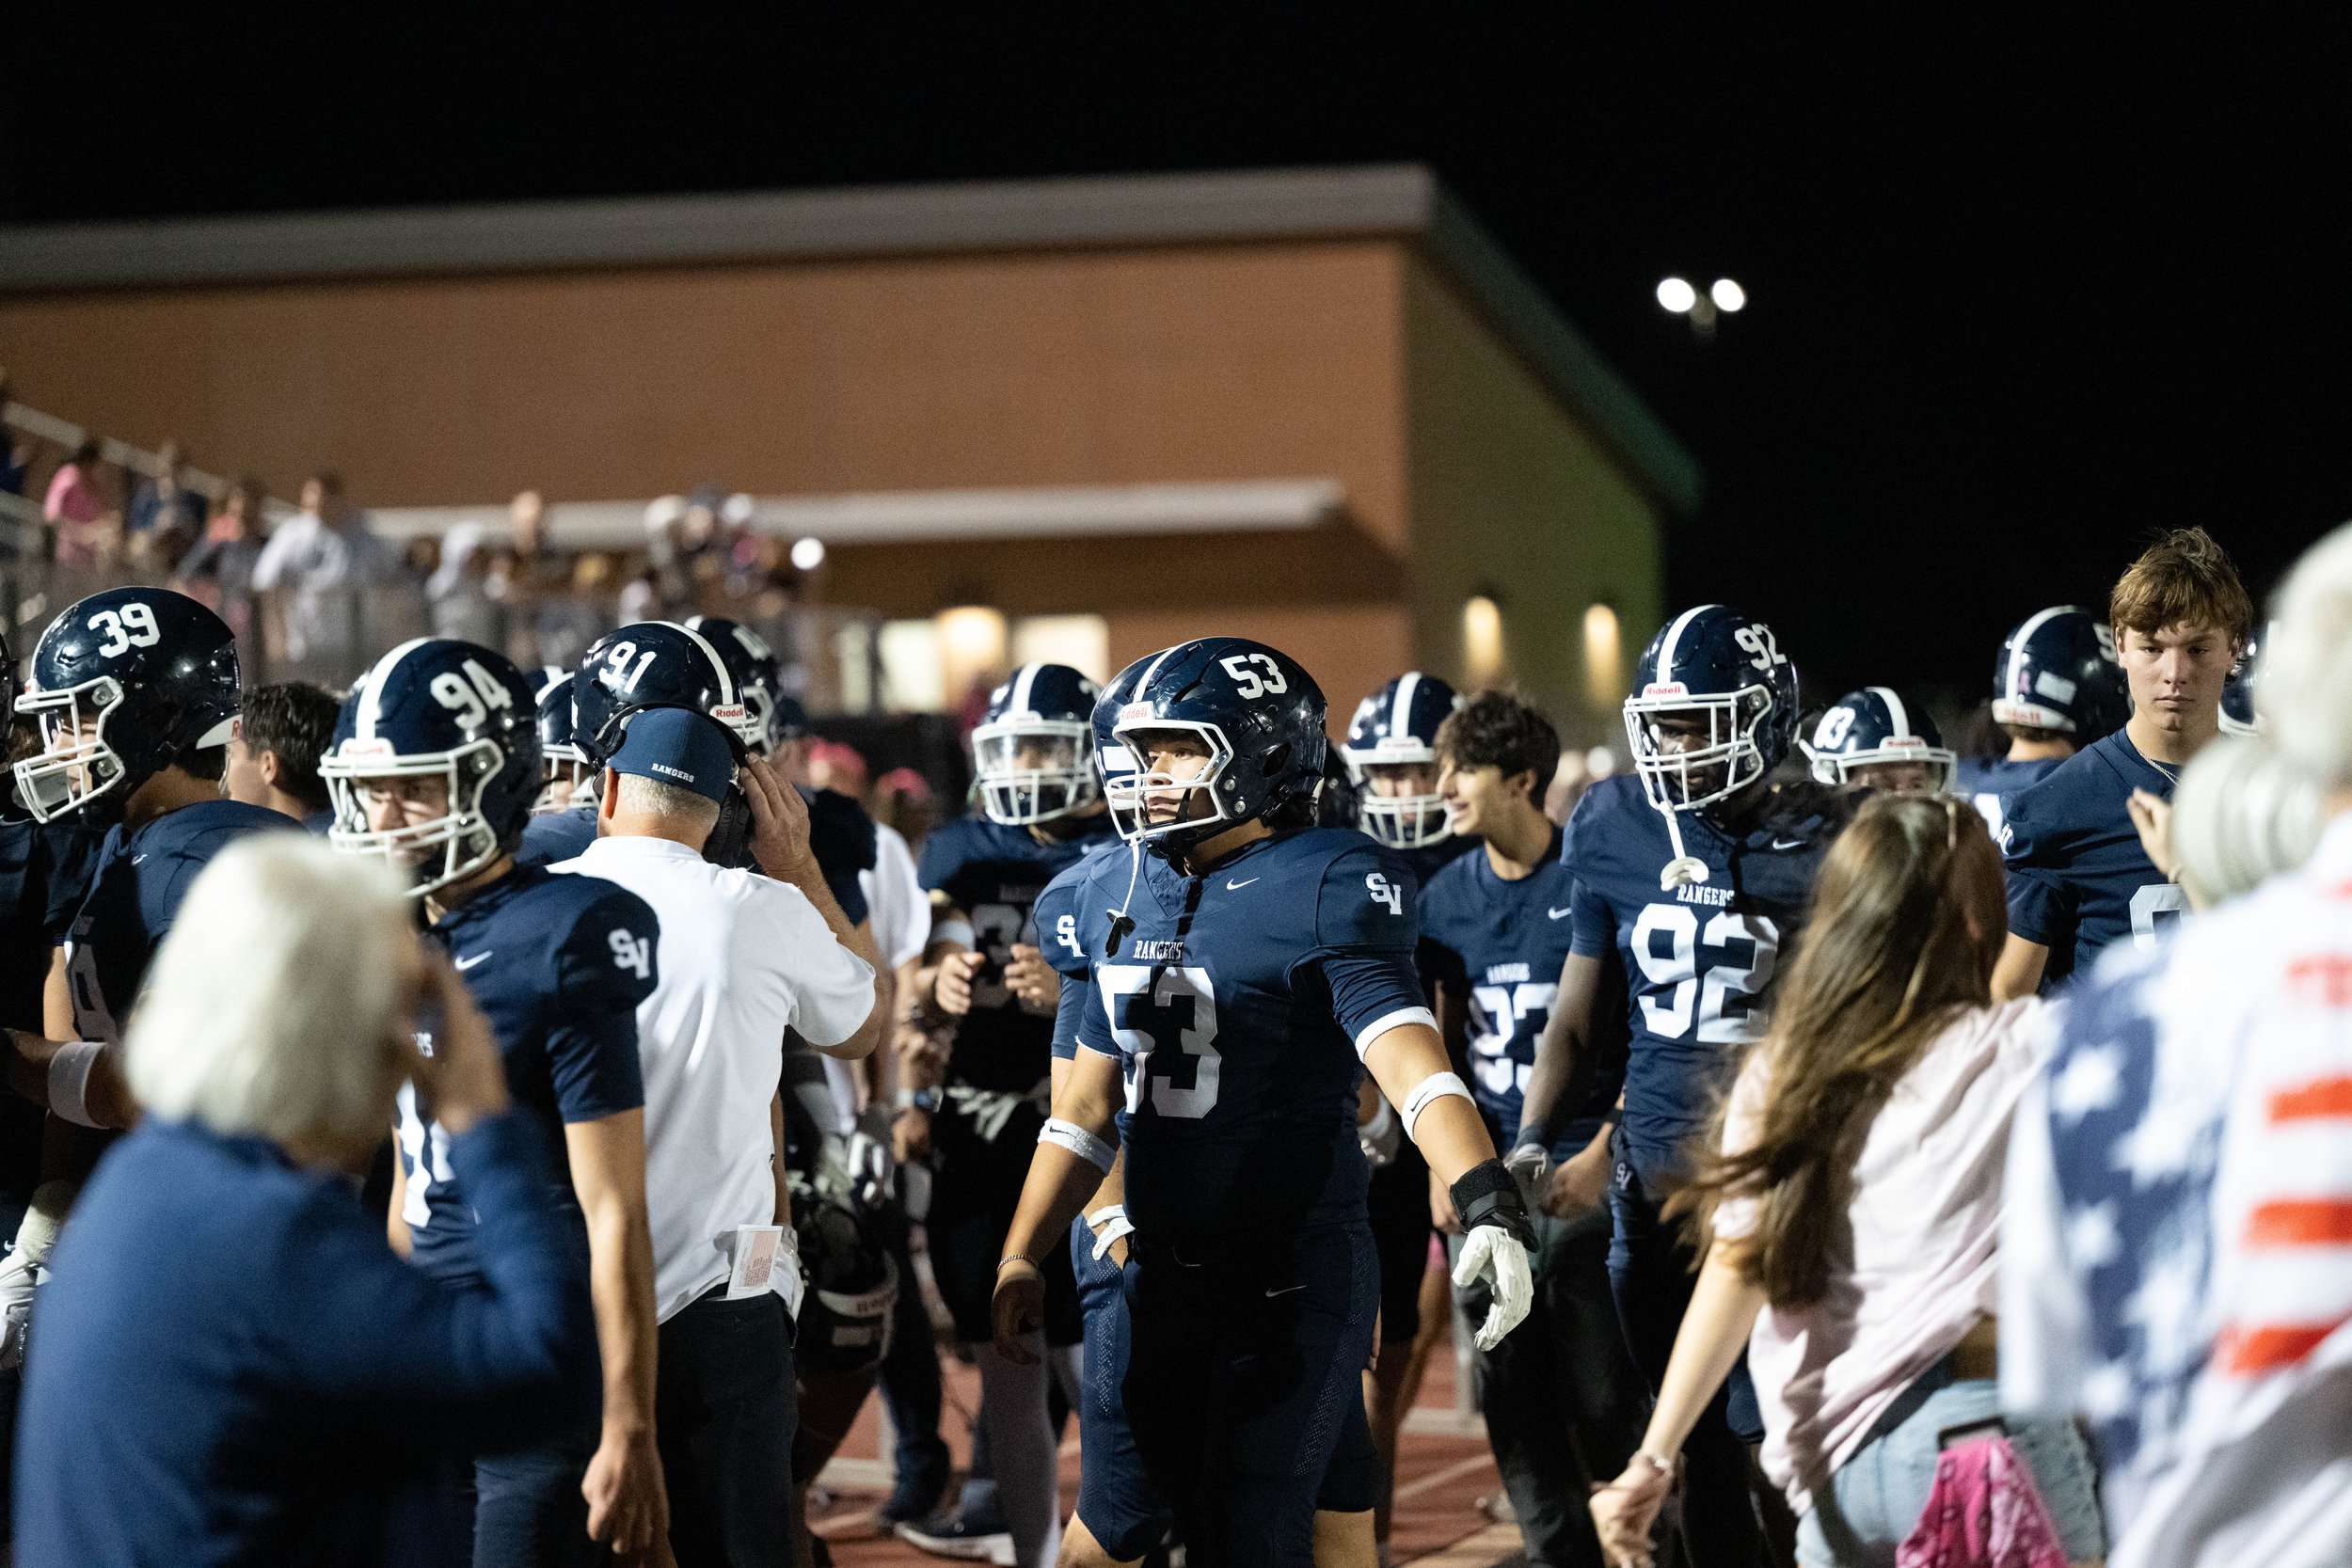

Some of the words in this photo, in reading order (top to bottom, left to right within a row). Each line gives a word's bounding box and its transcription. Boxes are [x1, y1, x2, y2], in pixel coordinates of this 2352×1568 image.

[87, 602, 161, 658] 39
[1734, 623, 1788, 671] 92
[598, 641, 657, 695] 91
[1218, 653, 1288, 700] 53
[1646, 685, 1681, 696] Riddell
[430, 658, 513, 730] 94
[651, 763, 695, 784] RANGERS
[1365, 872, 1403, 915] SV
[1676, 883, 1736, 908] RANGERS
[608, 927, 651, 980] SV
[1133, 940, 1184, 961] RANGERS
[1630, 902, 1780, 1045] 92
[1096, 964, 1223, 1120] 53
